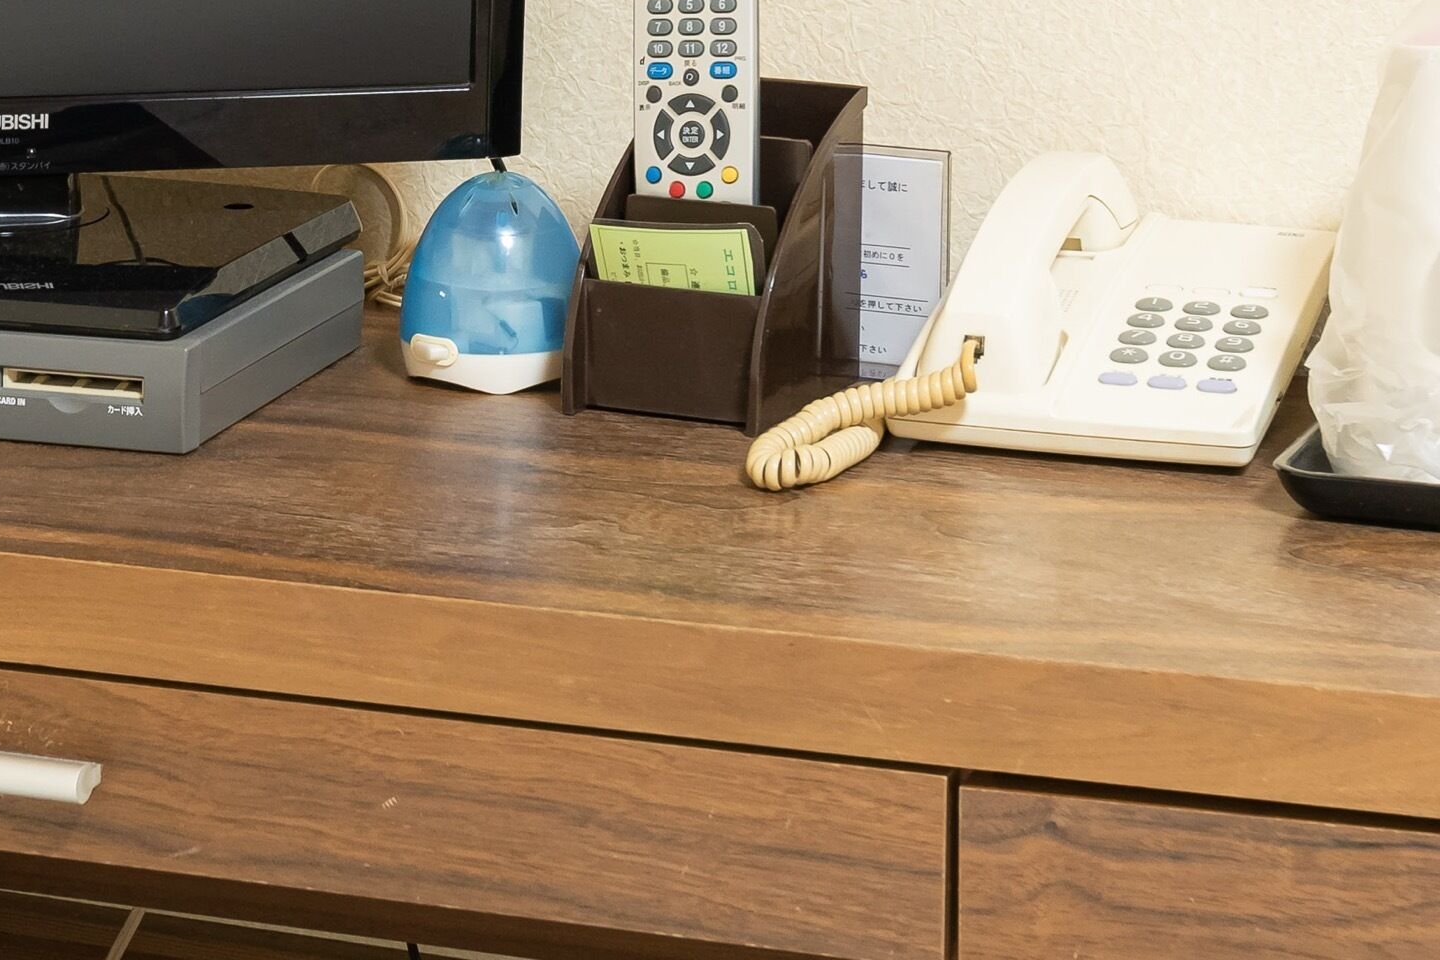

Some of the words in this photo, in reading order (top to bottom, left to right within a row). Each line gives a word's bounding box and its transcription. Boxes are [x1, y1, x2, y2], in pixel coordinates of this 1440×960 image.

[654, 0, 662, 11] 4
[686, 0, 693, 10] 5
[654, 21, 662, 33] 7
[686, 20, 693, 32] 8
[718, 20, 726, 31] 9
[653, 43, 664, 54] 10
[684, 43, 695, 54] 11
[716, 42, 729, 54] 12
[682, 126, 699, 135] 決定
[1137, 313, 1152, 321] 4
[1187, 317, 1201, 325] 5
[1234, 321, 1249, 329] 6
[1131, 330, 1146, 338] 7
[1178, 333, 1193, 342] 8
[1227, 337, 1242, 346] 9
[1169, 352, 1186, 360] 0
[17, 398, 26, 407] IN
[107, 405, 143, 417] カード挿入
